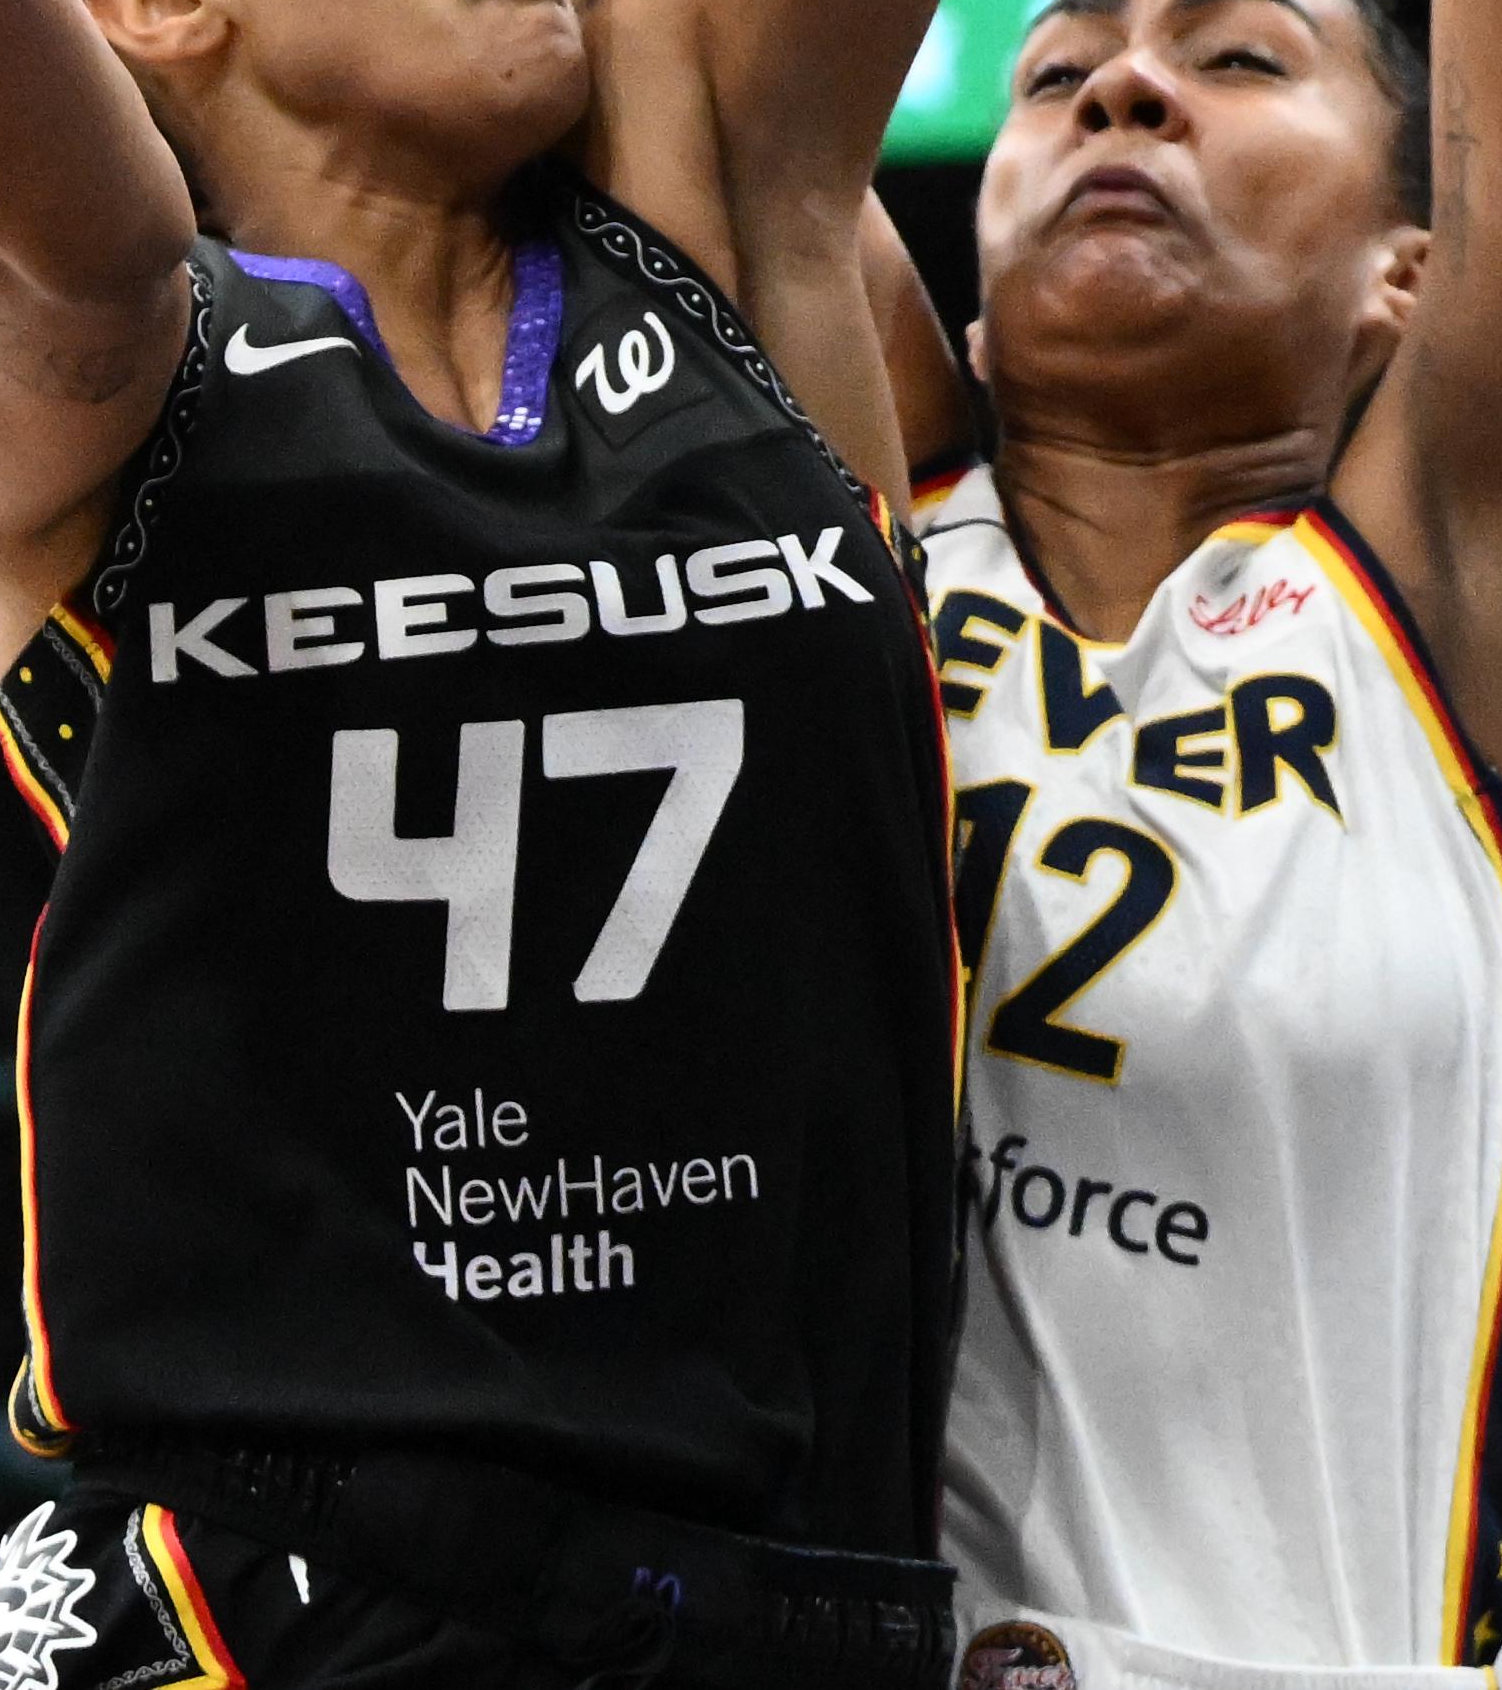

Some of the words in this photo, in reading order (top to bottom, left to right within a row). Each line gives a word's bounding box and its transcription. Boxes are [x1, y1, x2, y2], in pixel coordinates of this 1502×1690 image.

[147, 525, 875, 685] KEESUSK
[932, 586, 1348, 834] EVER
[327, 698, 744, 1011] 47
[395, 1087, 529, 1152] Yale
[404, 1151, 760, 1229] NewHaven
